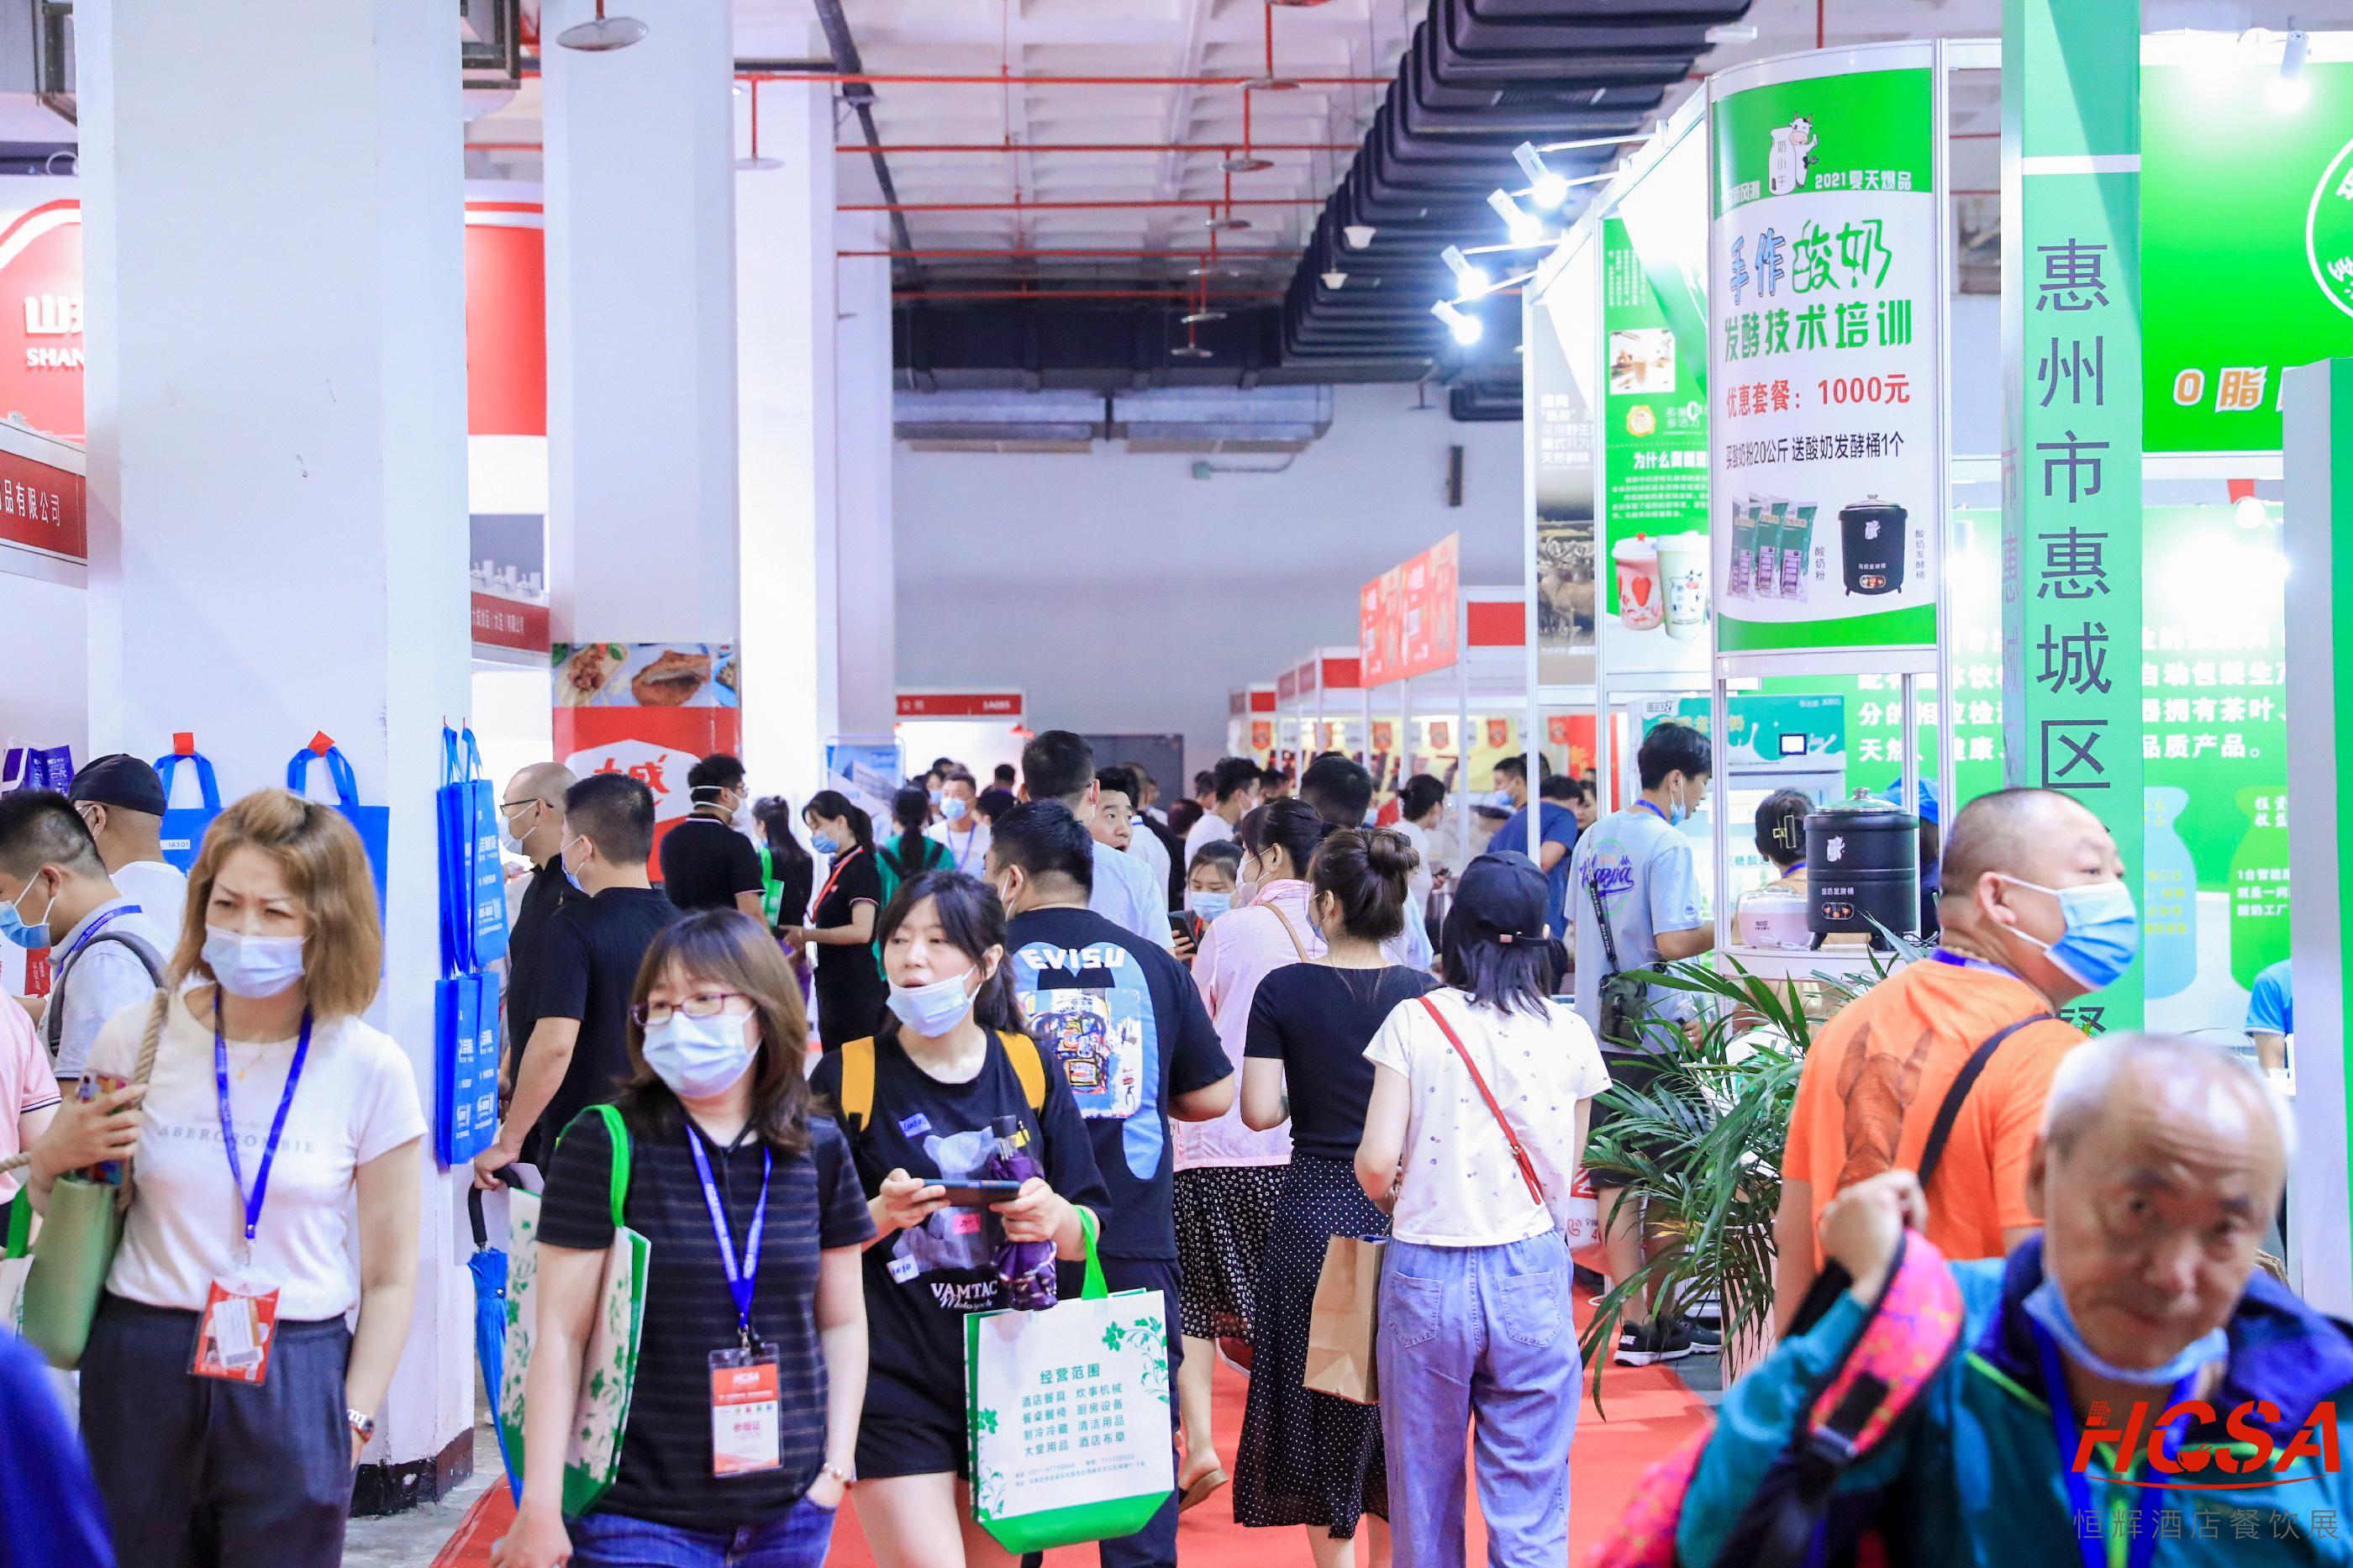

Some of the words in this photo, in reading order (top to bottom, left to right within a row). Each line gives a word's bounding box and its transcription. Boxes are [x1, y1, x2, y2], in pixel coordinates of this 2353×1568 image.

[1724, 299, 1913, 363] 发酵技术培训
[0, 479, 61, 527] 品有限公司
[1814, 545, 1825, 581] 酸奶粉
[2035, 238, 2112, 1033] 惠州市惠城区
[1019, 947, 1126, 970] EVISU
[158, 1125, 316, 1152] ABERCOBIE
[930, 1280, 998, 1299] VAMTAC
[1040, 1363, 1100, 1386] 经营范围
[1022, 1391, 1066, 1408] 酒店餐具
[1076, 1398, 1123, 1415] 厨房设备
[1078, 1415, 1125, 1432] 清洁用品
[1024, 1439, 1069, 1458] 大堂用品
